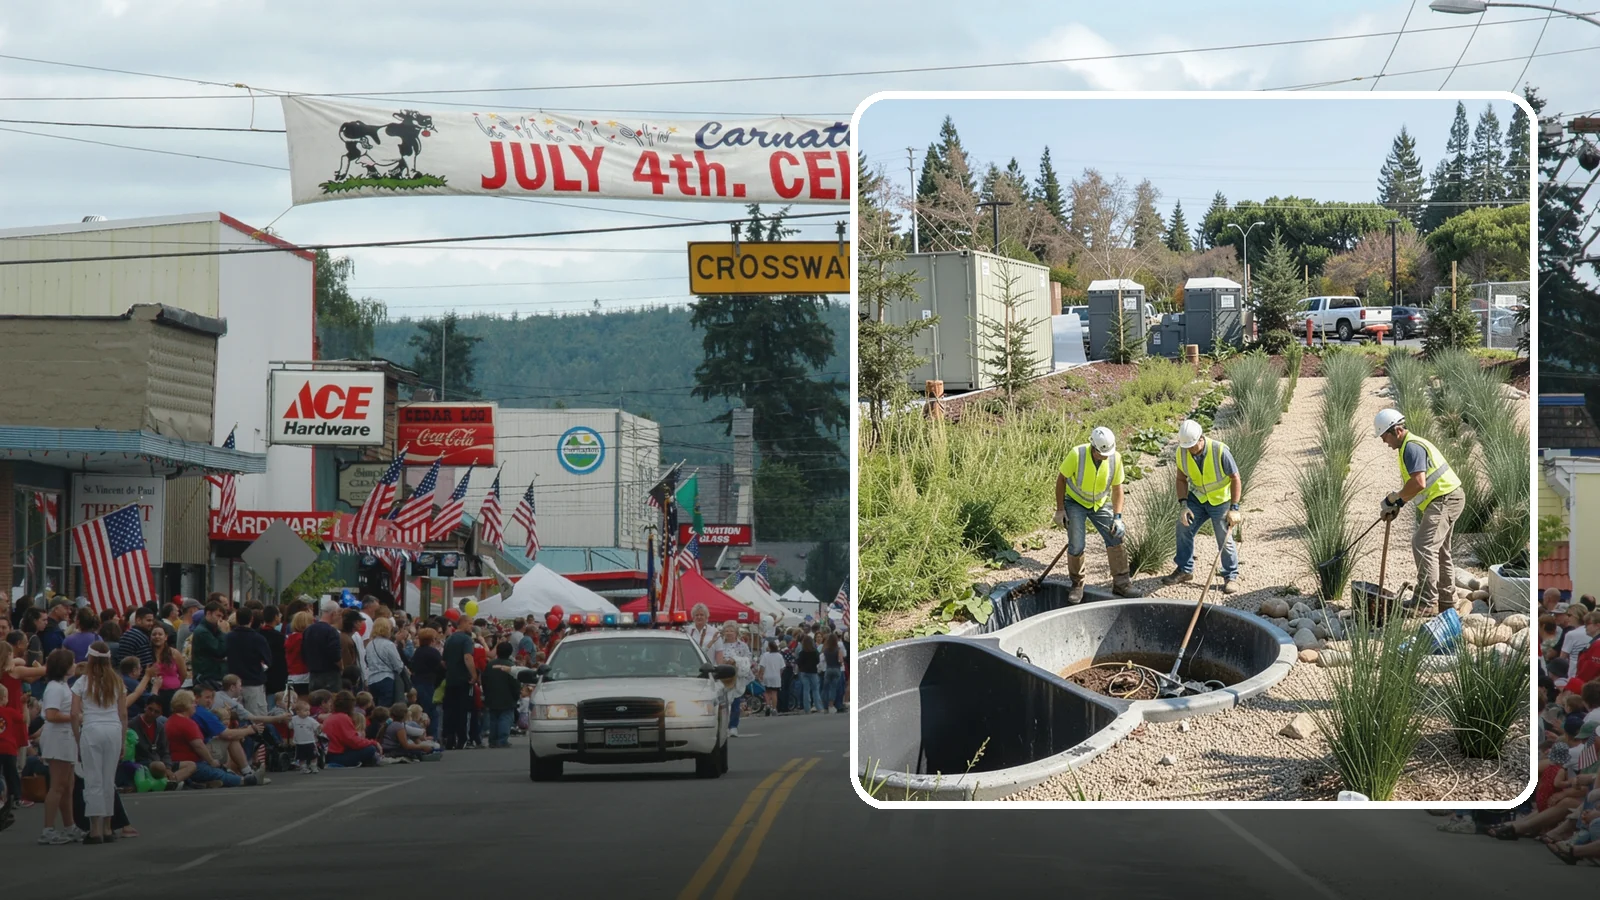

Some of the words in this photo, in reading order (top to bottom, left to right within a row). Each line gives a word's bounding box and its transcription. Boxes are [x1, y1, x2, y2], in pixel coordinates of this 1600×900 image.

[481, 141, 604, 192] JULY
[632, 149, 746, 197] 4th.
[697, 254, 850, 280] CROSSWA
[282, 380, 373, 419] ACE
[405, 409, 453, 422] CEDAR
[283, 421, 370, 436] Hardware
[416, 428, 476, 447] Coca-Cola
[354, 467, 384, 481] Simpl
[96, 485, 124, 495] Vincent
[126, 486, 136, 495] de
[138, 486, 155, 495] Paul
[688, 527, 741, 535] CRNATION
